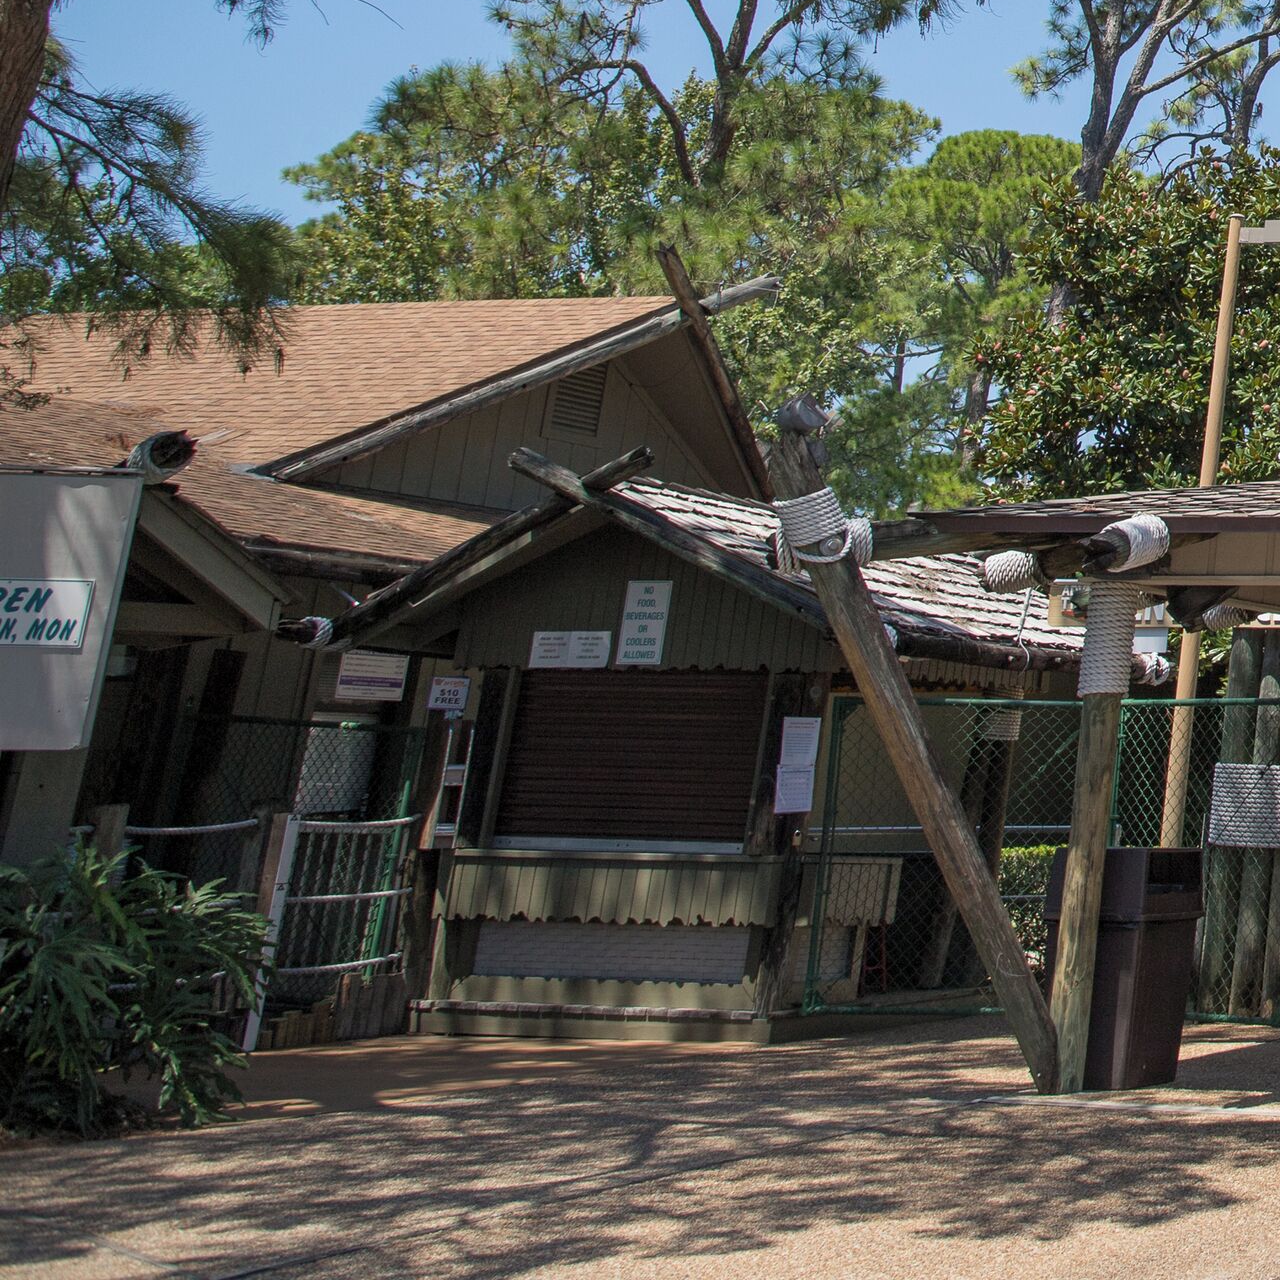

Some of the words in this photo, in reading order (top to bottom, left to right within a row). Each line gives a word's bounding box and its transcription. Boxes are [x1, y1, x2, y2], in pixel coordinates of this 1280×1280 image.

[644, 586, 654, 594] NO
[26, 618, 77, 640] MON
[626, 638, 656, 646] COOLERS
